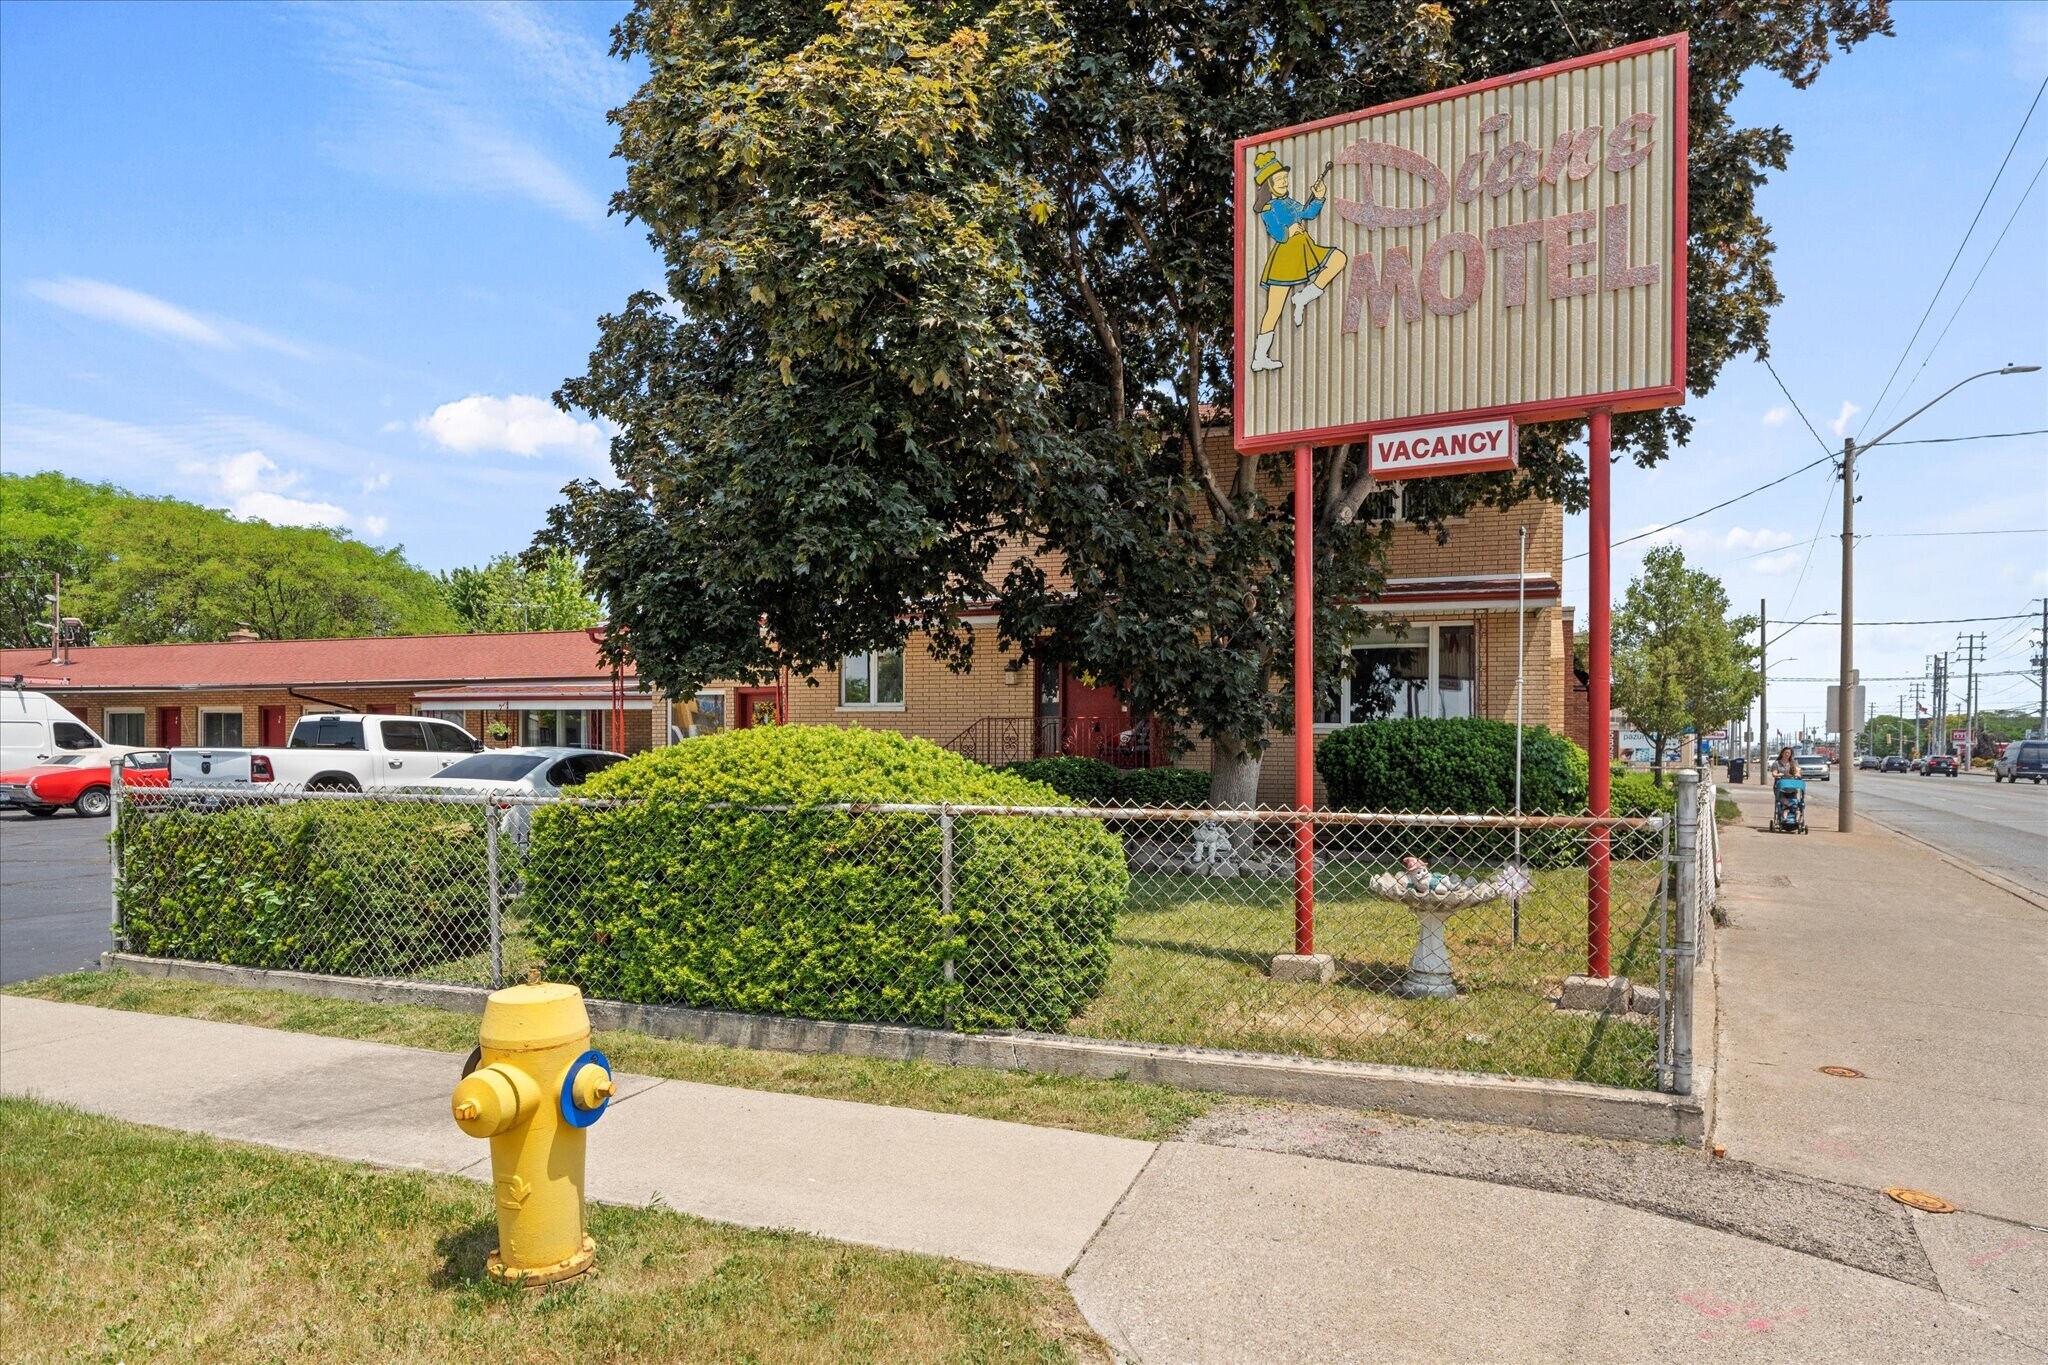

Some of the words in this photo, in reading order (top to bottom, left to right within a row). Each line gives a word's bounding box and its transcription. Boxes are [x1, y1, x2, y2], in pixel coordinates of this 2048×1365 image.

[1335, 113, 1656, 231] Diane
[1342, 203, 1660, 334] MOTEL
[1378, 430, 1502, 462] VACANCY
